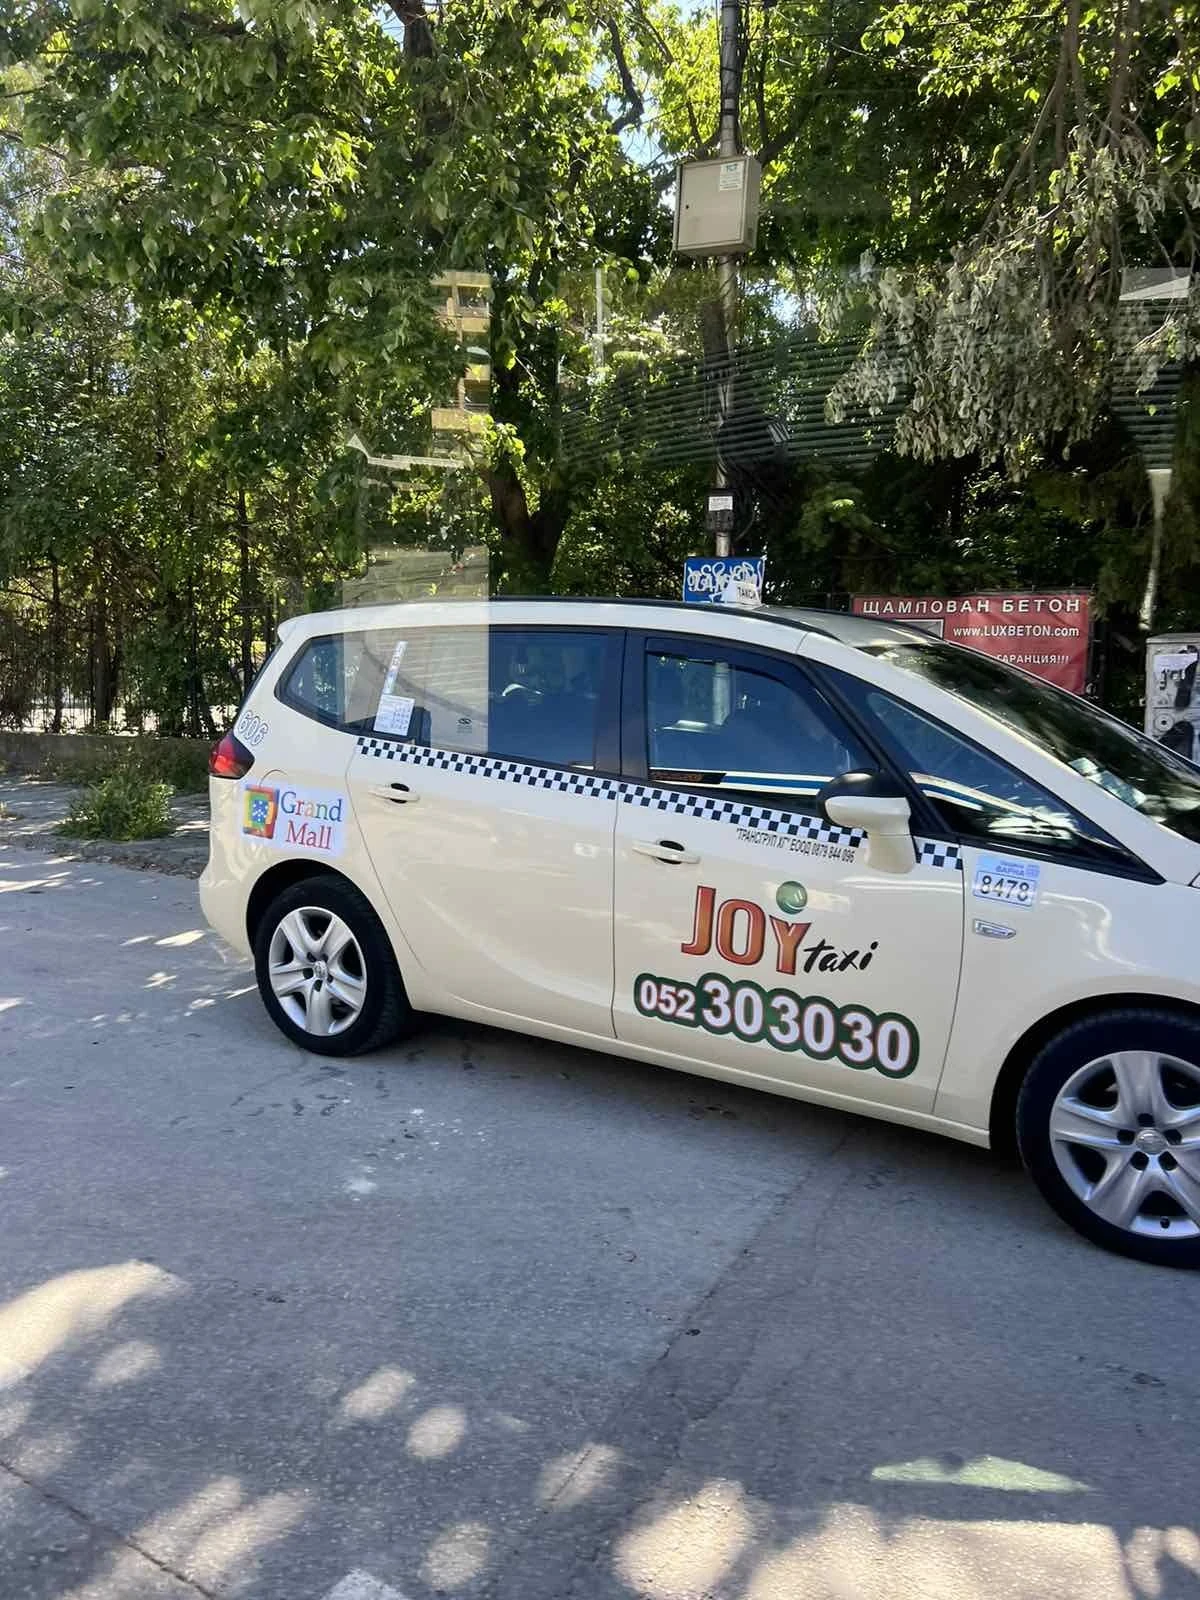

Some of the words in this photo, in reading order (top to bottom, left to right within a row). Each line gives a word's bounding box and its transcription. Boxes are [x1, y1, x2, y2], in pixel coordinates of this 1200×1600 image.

[863, 600, 990, 614] ЩАМПОВАН
[1002, 599, 1080, 612] БЕТОН
[953, 625, 1080, 637] www.LUXBETON.com
[237, 710, 269, 746] 606
[280, 791, 342, 822] Grand
[285, 820, 332, 850] Mall
[980, 875, 1030, 902] 8478
[681, 885, 812, 976] JOY
[803, 939, 879, 974] taxi
[640, 980, 696, 1020] 052
